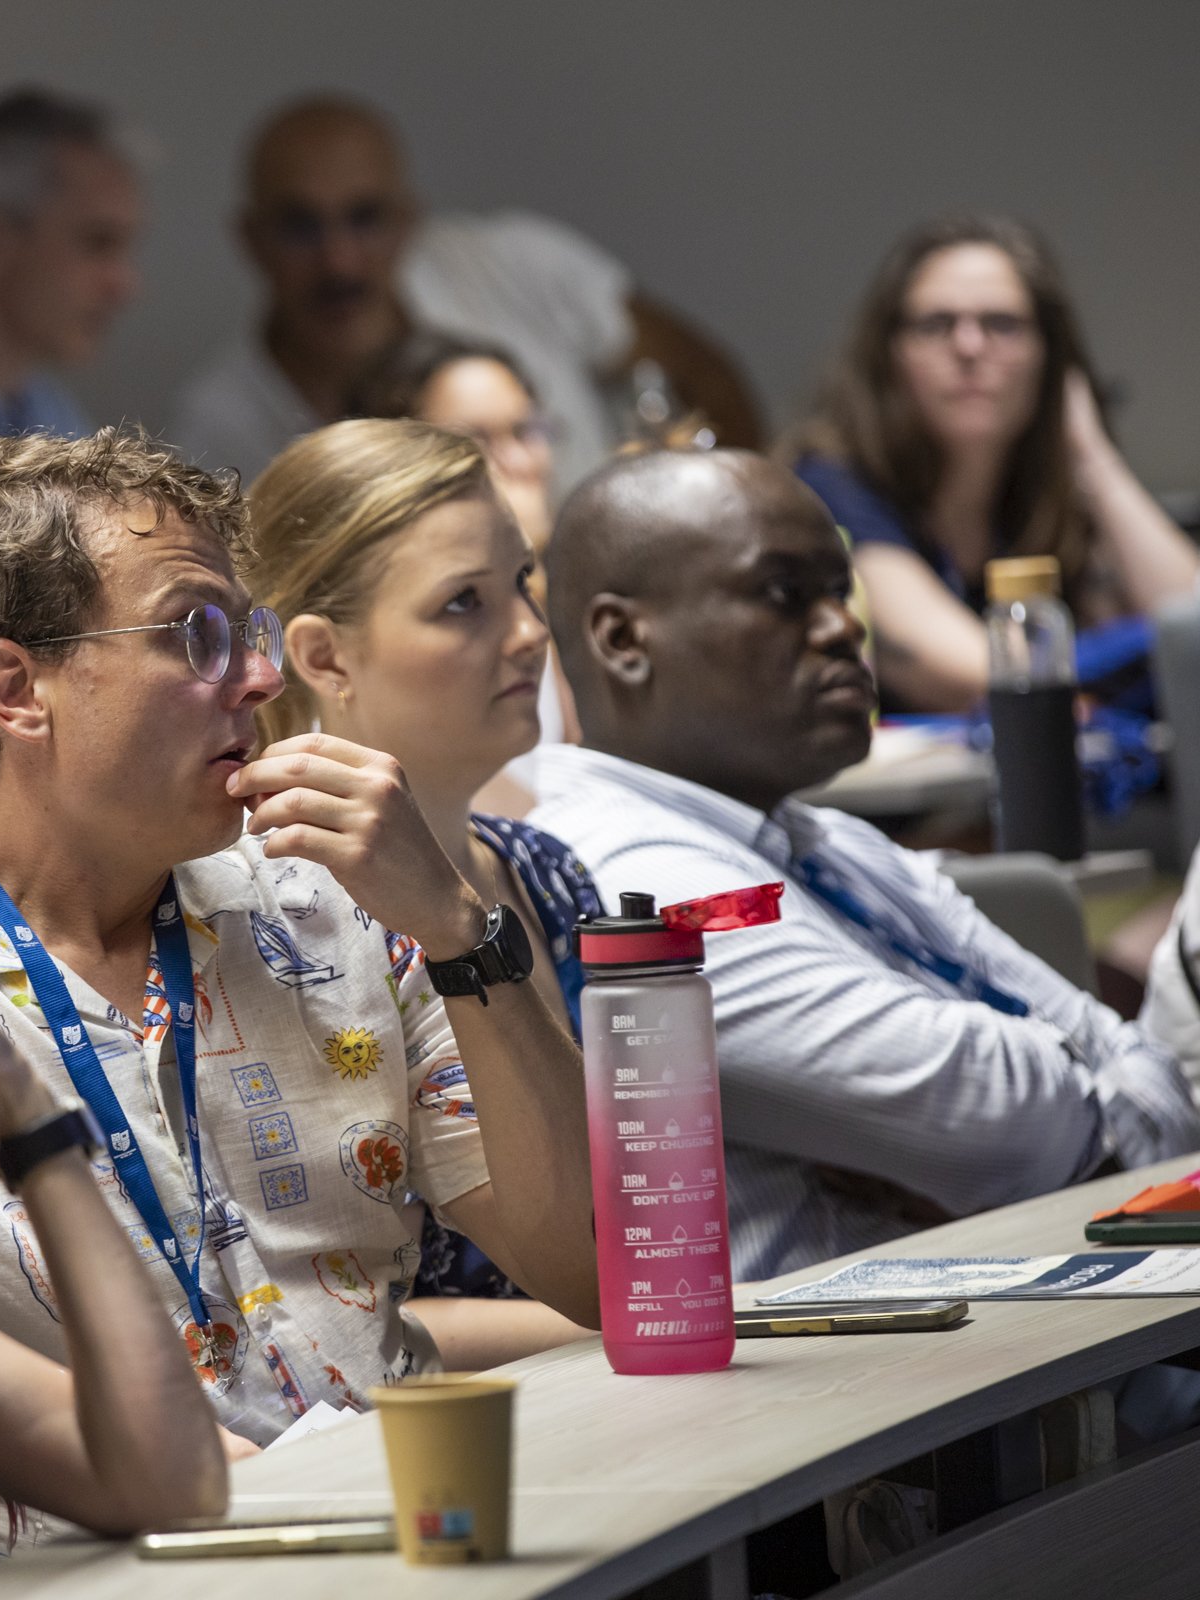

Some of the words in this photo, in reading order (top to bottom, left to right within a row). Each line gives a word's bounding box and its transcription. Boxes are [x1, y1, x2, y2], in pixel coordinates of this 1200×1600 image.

[612, 1015, 636, 1029] 8AM
[626, 1035, 649, 1046] GET
[433, 1068, 464, 1082] WELCO
[616, 1068, 639, 1082] 9AM
[614, 1088, 671, 1100] REMEMBER
[617, 1121, 645, 1135] 10AM
[625, 1141, 657, 1152] KEEP
[660, 1136, 714, 1150] CHUGGING
[622, 1174, 647, 1188] 11AM
[632, 1194, 669, 1206] DON'T
[672, 1192, 701, 1204] GIVE
[703, 1190, 715, 1200] UP
[624, 1227, 652, 1241] 12PM
[704, 1221, 721, 1236] 6PM
[634, 1247, 685, 1259] ALMOST
[688, 1243, 720, 1254] THERE
[631, 1281, 652, 1295] 1PM
[709, 1275, 725, 1289] 7PM
[627, 1302, 664, 1312] REFILL
[681, 1300, 702, 1309] YOU
[704, 1298, 719, 1307] DID
[636, 1320, 688, 1336] PHOENIX
